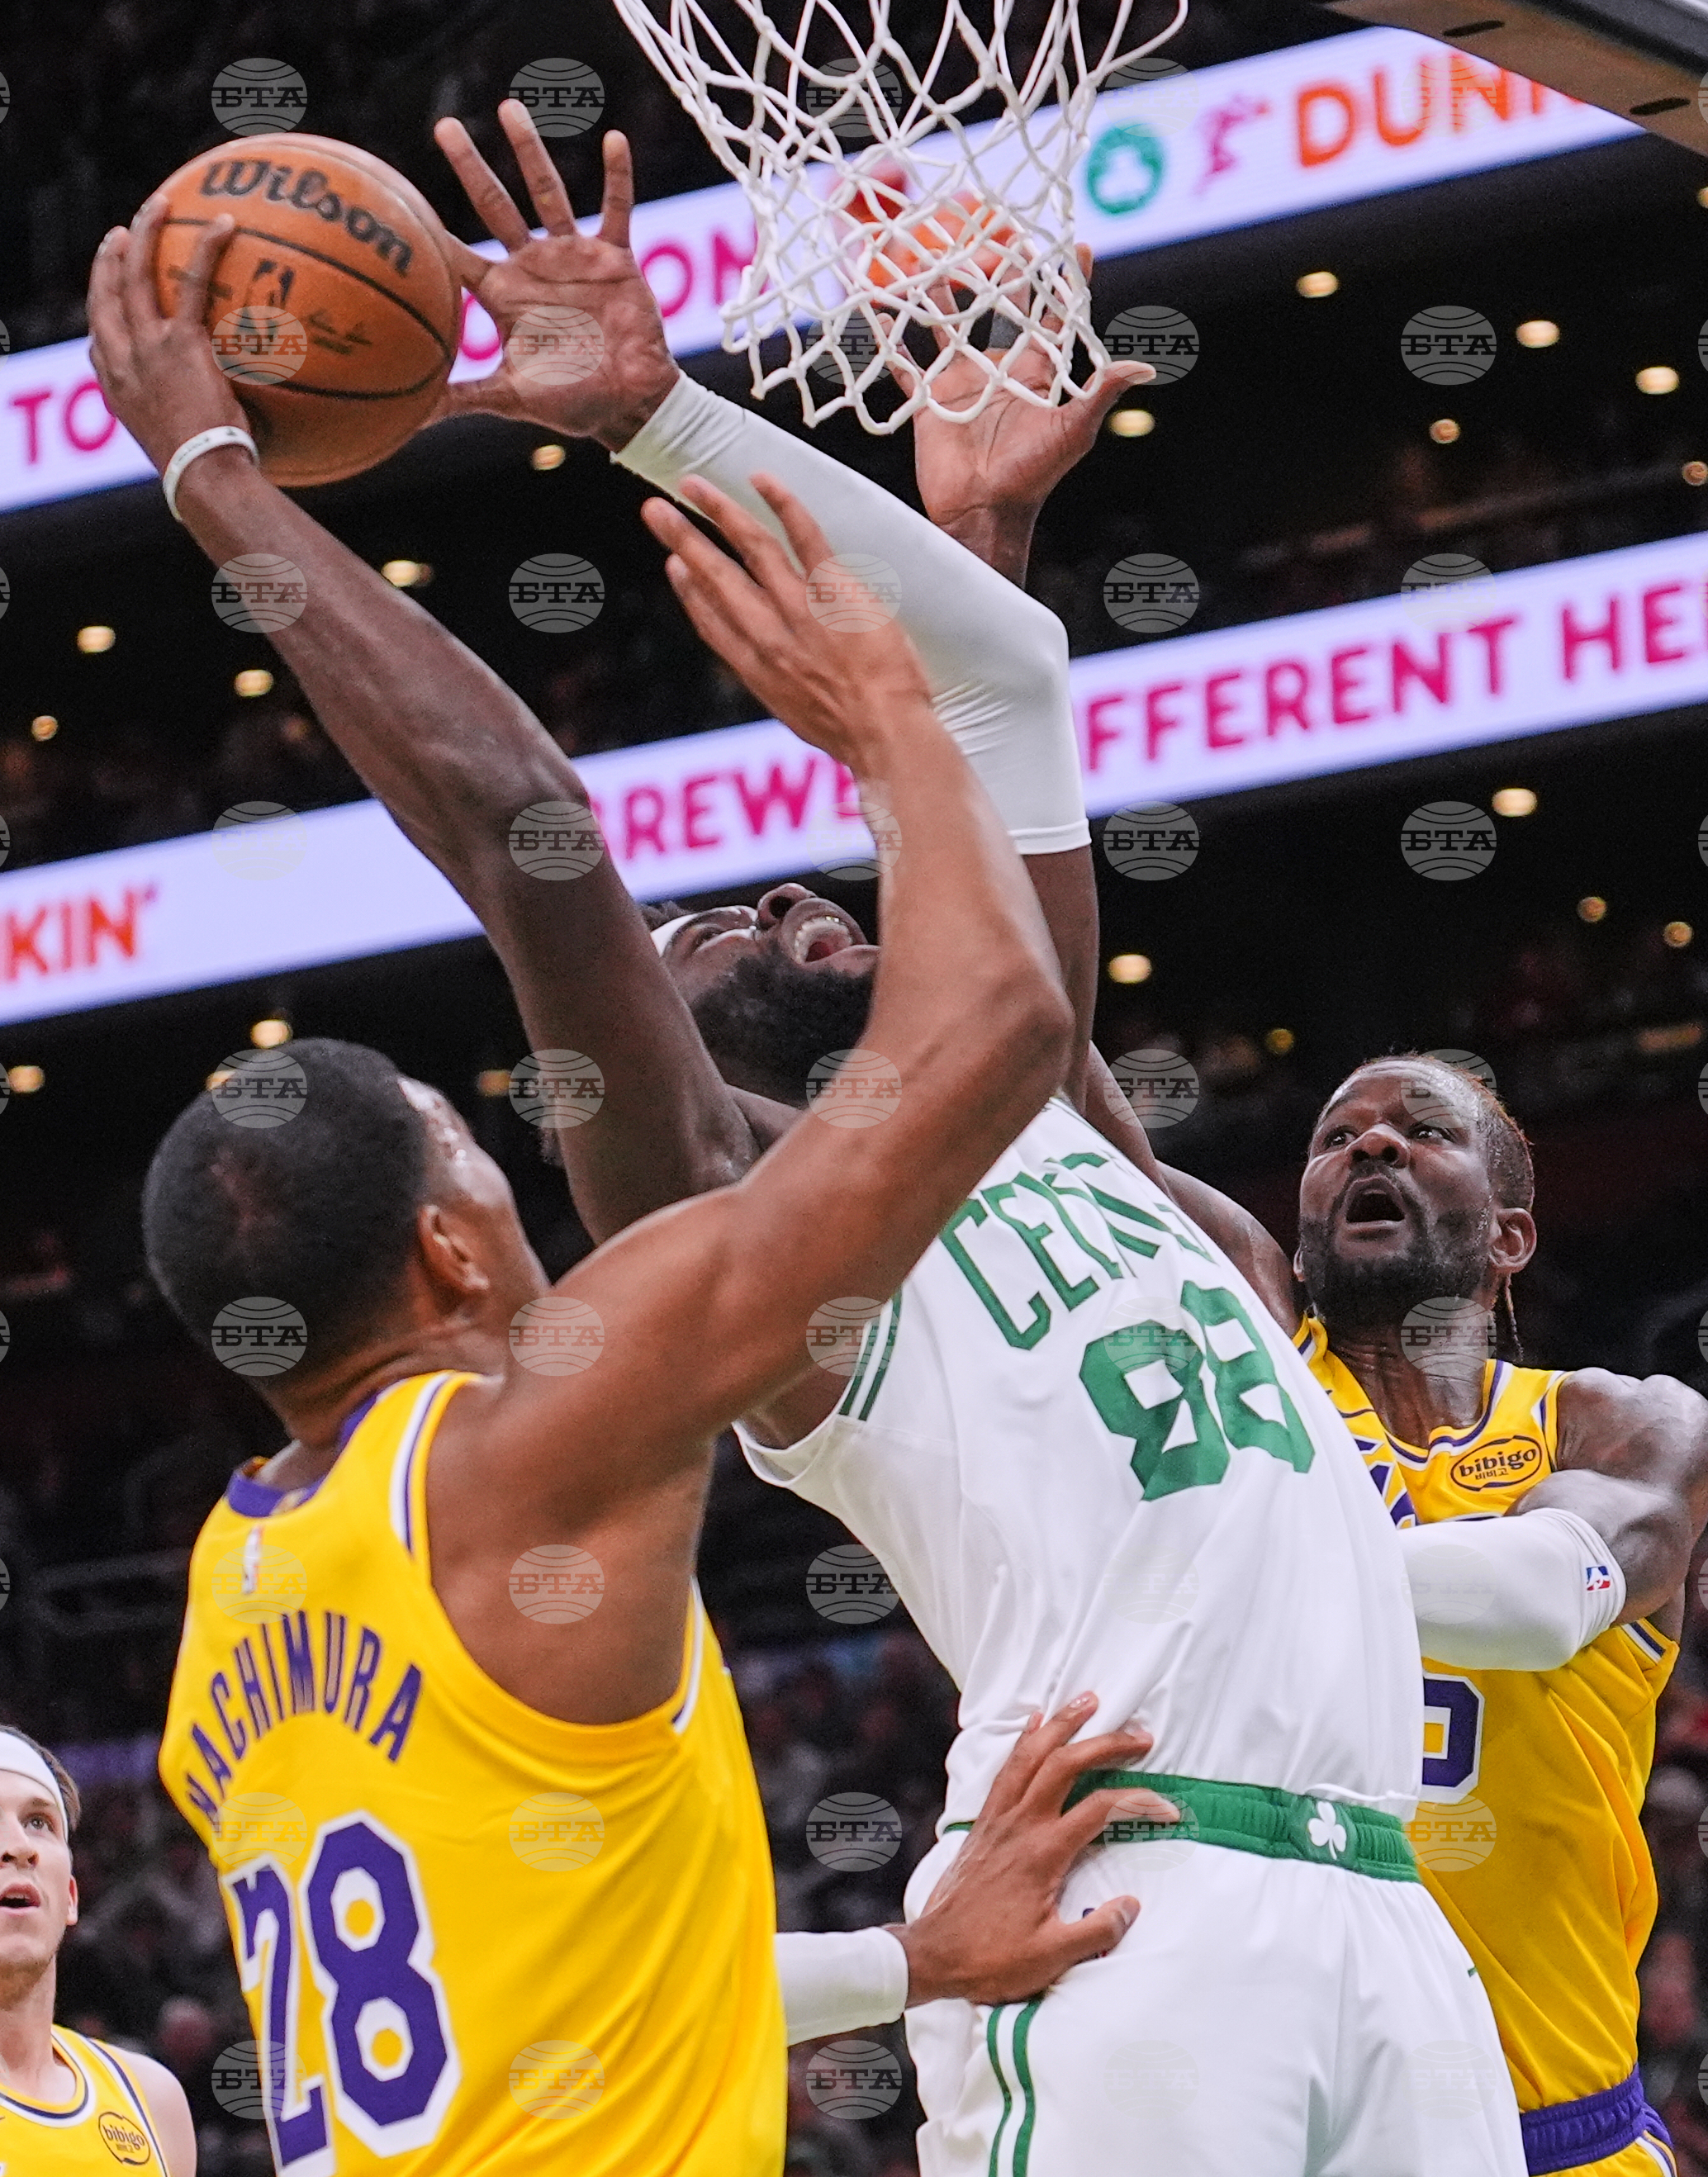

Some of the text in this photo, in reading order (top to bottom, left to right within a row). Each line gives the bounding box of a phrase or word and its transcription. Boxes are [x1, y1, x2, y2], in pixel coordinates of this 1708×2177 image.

[200, 160, 413, 278] Wilson
[590, 756, 861, 861] REW
[1562, 581, 1708, 680] HE
[1078, 1279, 1317, 1502] 88
[1459, 1448, 1537, 1477] bibigo
[1473, 1467, 1509, 1480] 비비고
[185, 1609, 423, 1837] HACHIMURA
[223, 1811, 461, 2177] 28
[102, 2123, 146, 2151] bibigo
